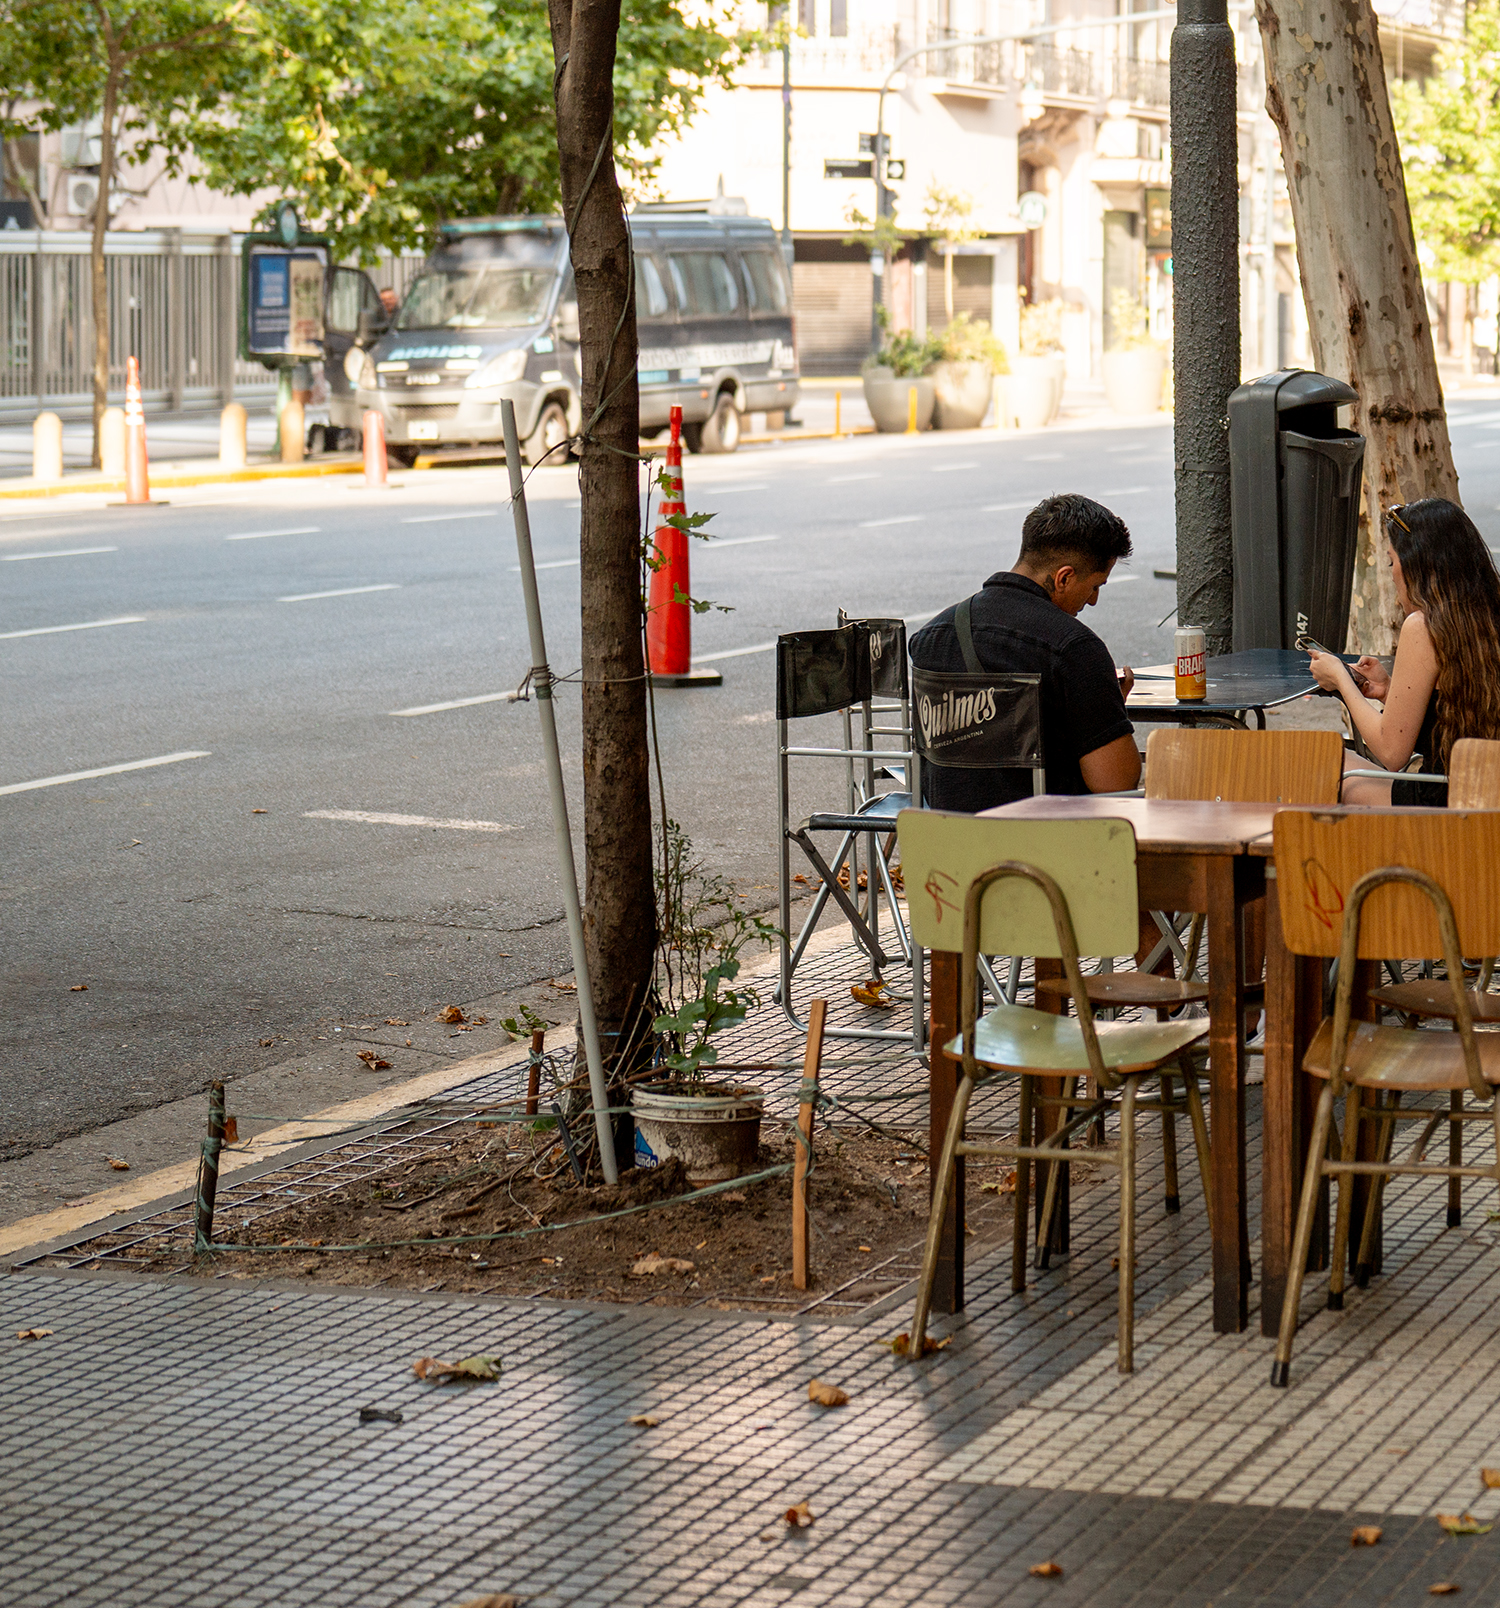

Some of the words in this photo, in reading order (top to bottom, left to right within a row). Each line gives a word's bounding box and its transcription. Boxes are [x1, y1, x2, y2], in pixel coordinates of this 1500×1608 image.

[1295, 611, 1309, 637] 147
[1178, 654, 1206, 676] BRAH
[919, 686, 997, 749] Quilmes
[933, 739, 953, 749] CERVEZA
[953, 729, 984, 743] ARGENTINA
[636, 1155, 657, 1167] undo
